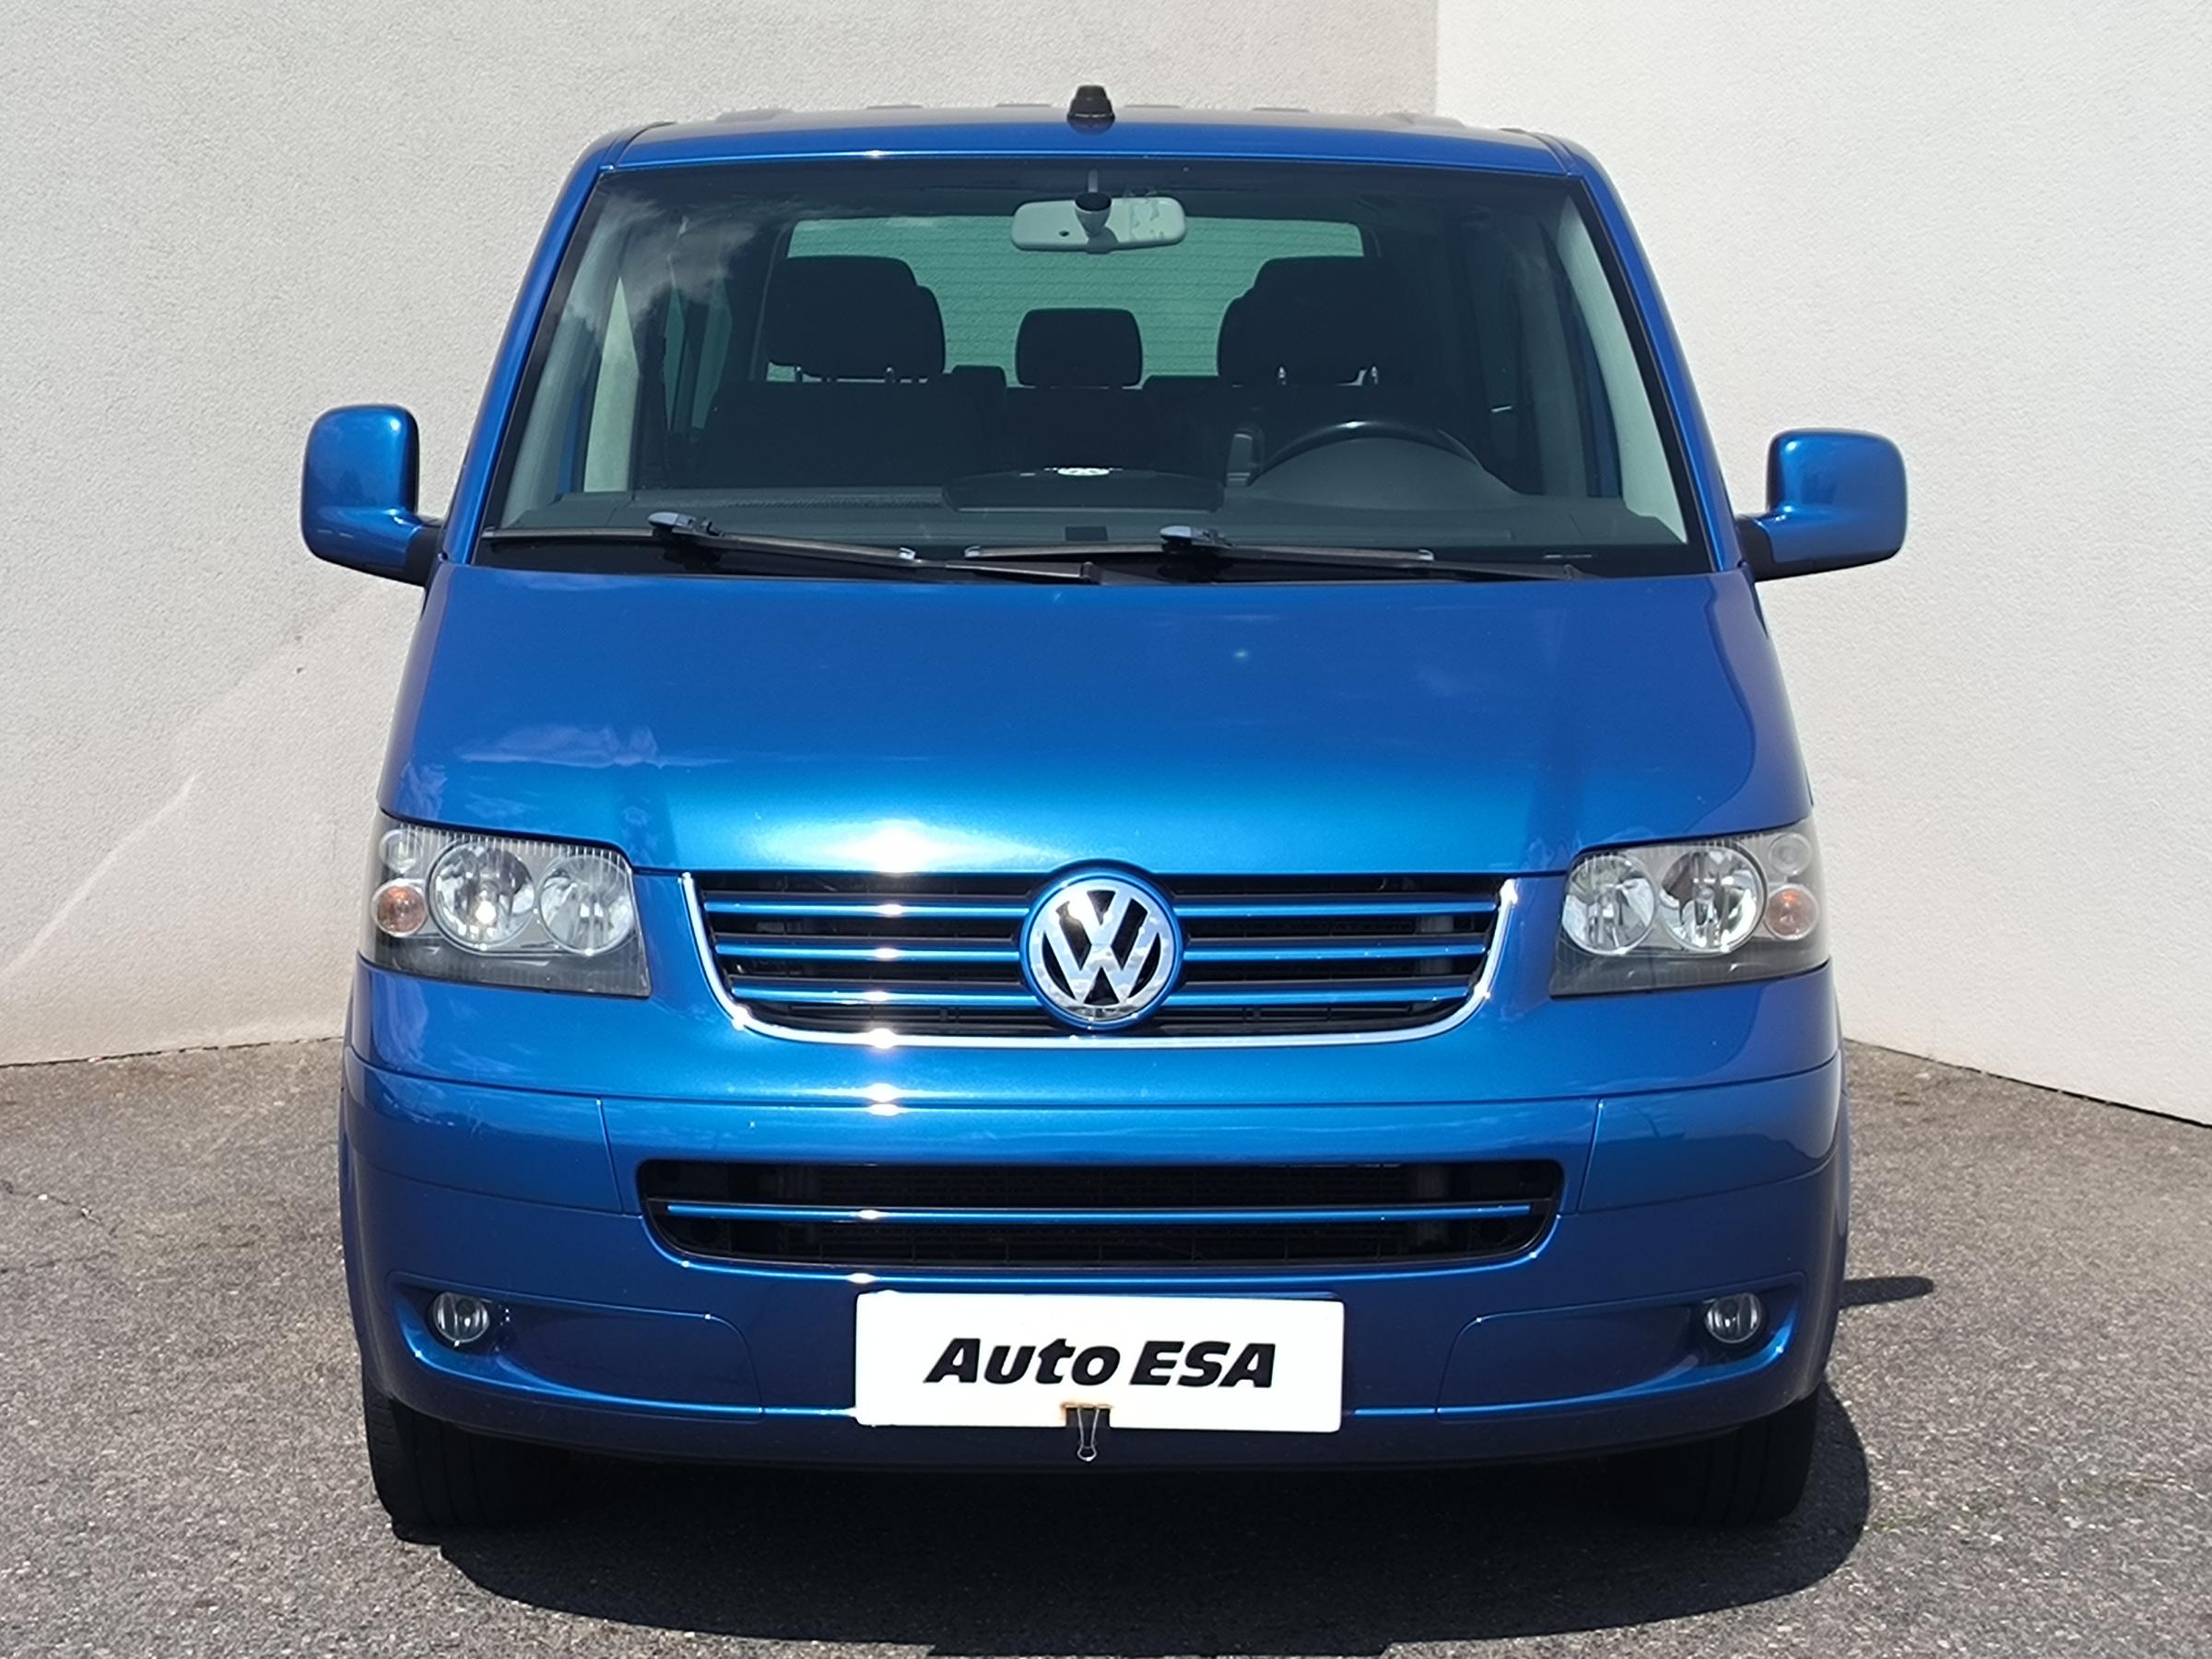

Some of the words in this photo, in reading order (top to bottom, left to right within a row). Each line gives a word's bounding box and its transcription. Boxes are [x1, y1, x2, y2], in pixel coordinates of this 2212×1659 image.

[1033, 884, 1170, 1014] VW
[923, 1337, 1121, 1386] Auto
[1129, 1340, 1277, 1389] ESA
